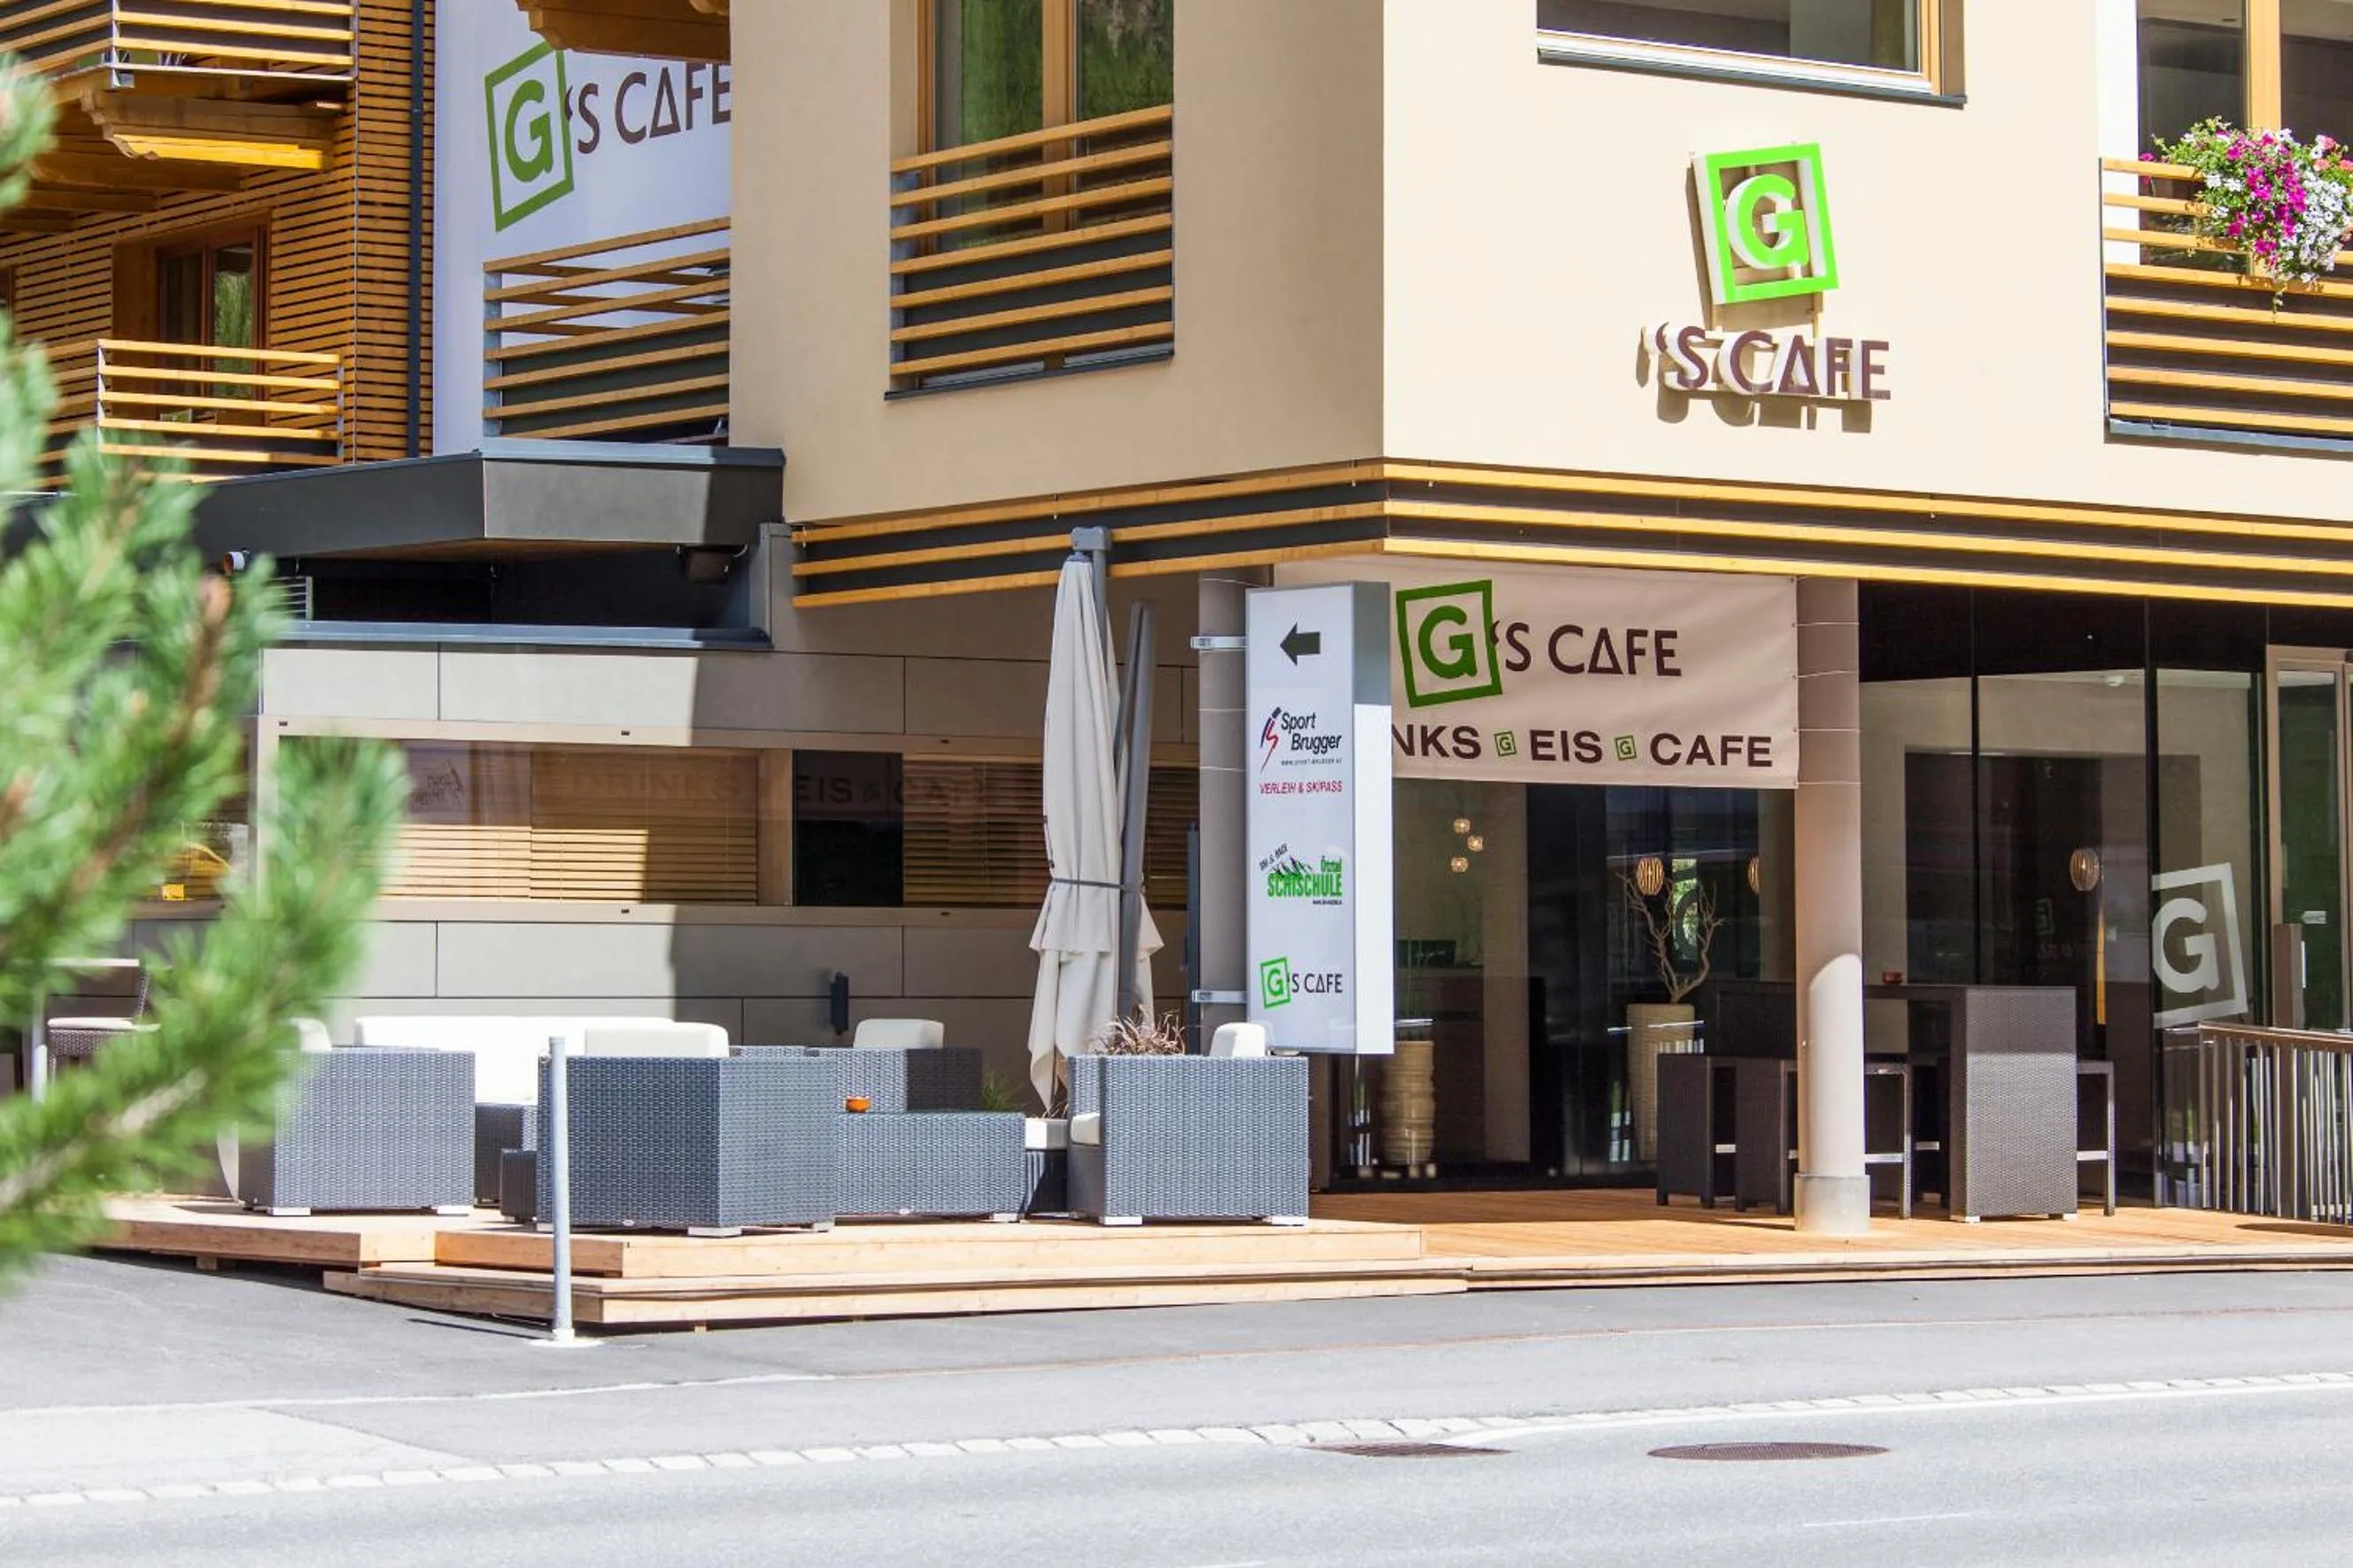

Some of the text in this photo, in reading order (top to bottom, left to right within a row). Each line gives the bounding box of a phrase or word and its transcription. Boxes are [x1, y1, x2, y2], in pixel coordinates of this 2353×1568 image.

[615, 62, 731, 144] CAFE
[1727, 174, 1809, 270] G
[1728, 329, 1892, 400] CAFE
[1547, 622, 1683, 677] CAFE
[1281, 712, 1316, 733] Sport
[1290, 733, 1342, 755] Brugger
[1529, 729, 1603, 764] EIS
[1649, 732, 1774, 768] CAFE
[2152, 898, 2220, 993] G
[1304, 973, 1343, 993] CAFE
